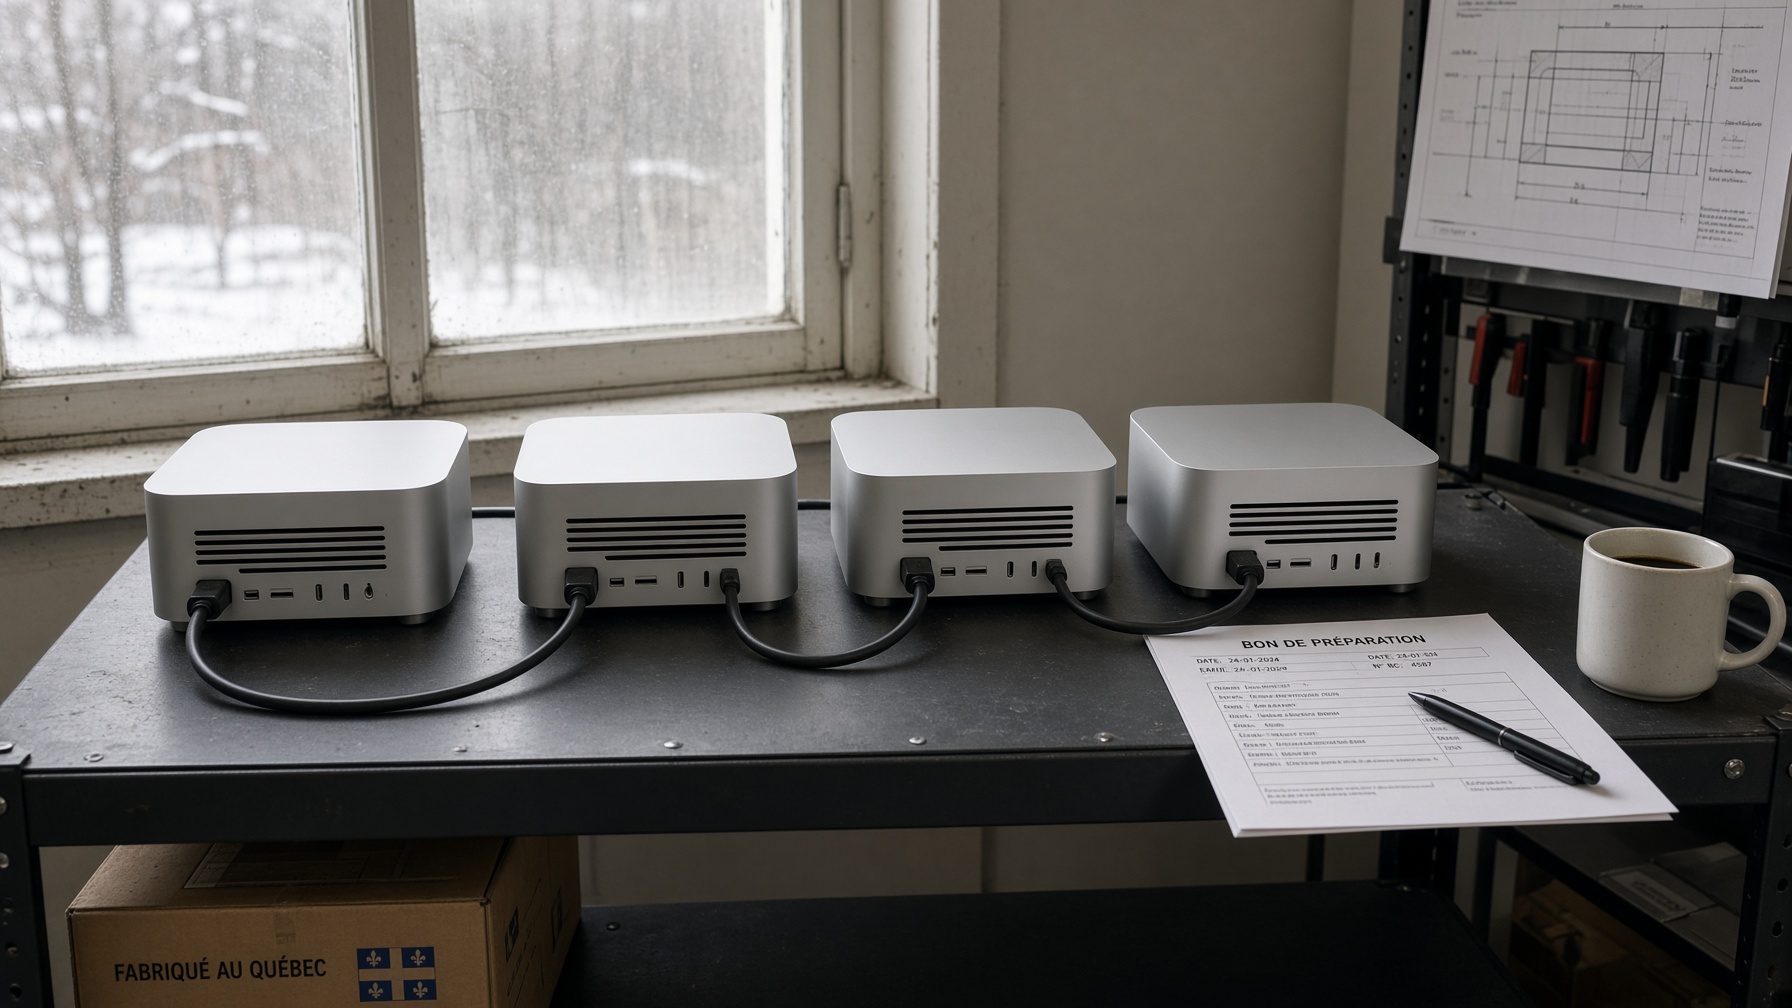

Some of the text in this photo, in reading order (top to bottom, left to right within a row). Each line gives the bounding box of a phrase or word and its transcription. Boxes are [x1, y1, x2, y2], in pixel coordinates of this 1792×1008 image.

[1241, 635, 1426, 649] BON DE PRÉPARATION
[114, 955, 327, 982] FABRIQUÉ AU QUÉBEC
